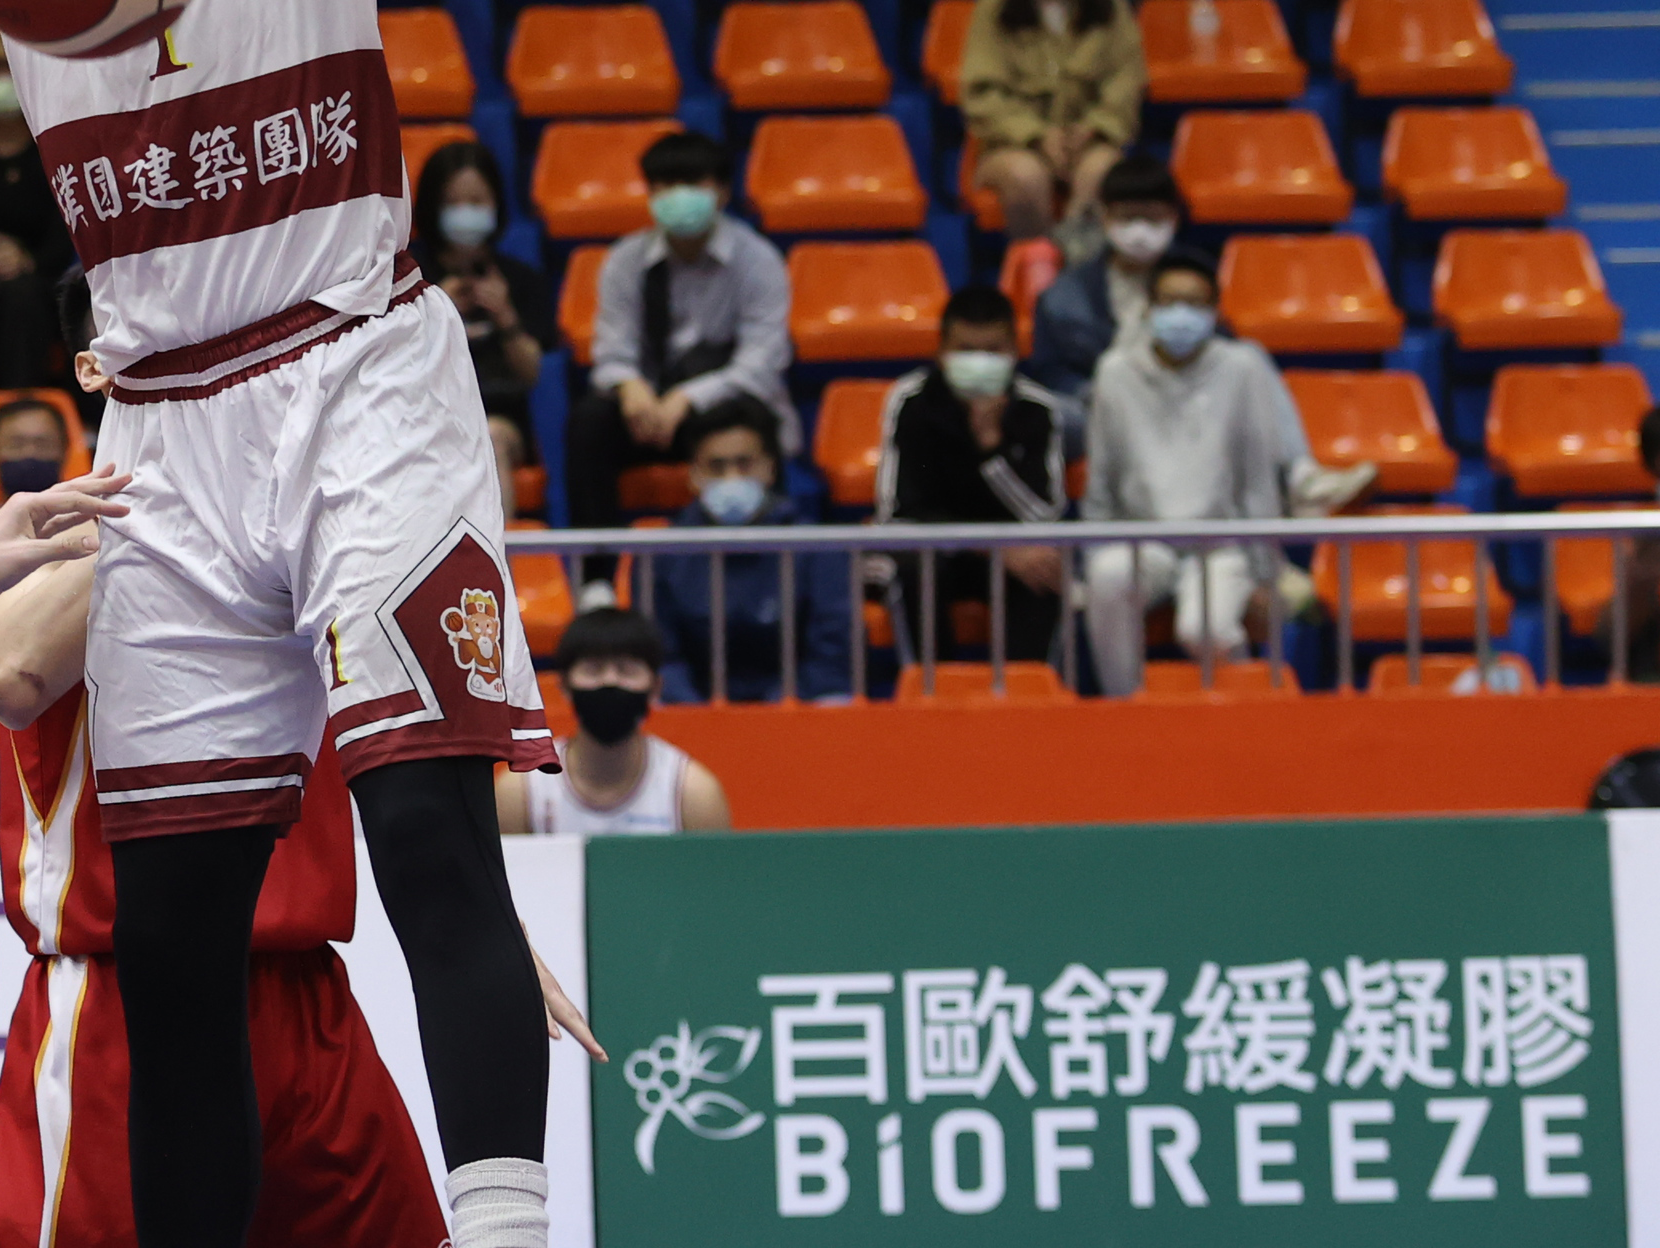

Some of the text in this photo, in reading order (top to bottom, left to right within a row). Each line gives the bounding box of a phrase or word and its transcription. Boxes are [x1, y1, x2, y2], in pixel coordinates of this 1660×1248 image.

[758, 954, 1594, 1107] 百歐舒緩凝膠
